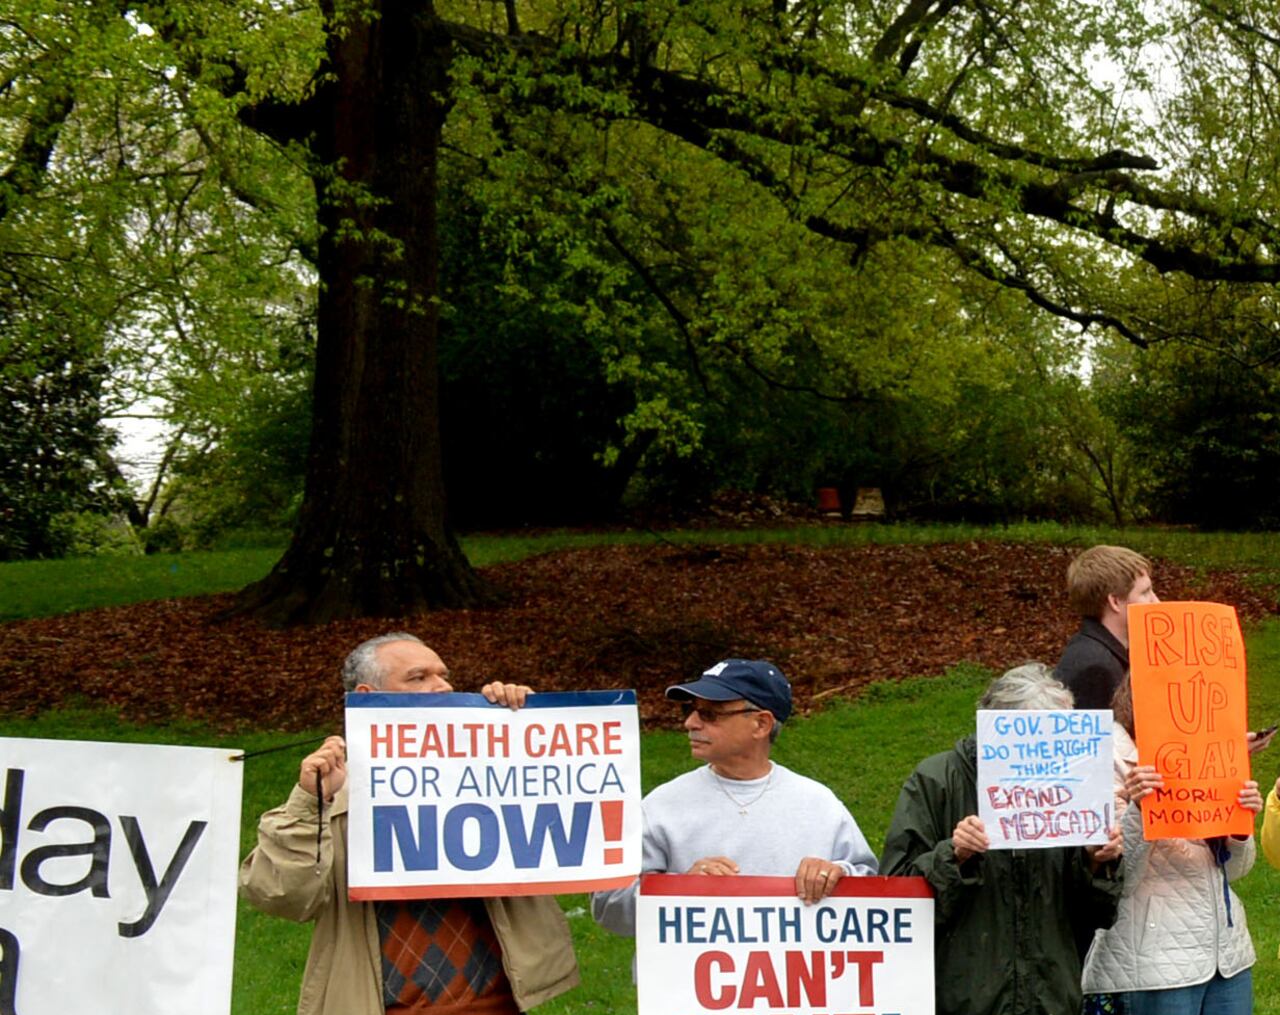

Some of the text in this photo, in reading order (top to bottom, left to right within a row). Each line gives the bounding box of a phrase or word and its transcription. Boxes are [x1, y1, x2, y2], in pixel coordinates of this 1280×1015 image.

[1144, 611, 1237, 669] RISE
[1167, 671, 1228, 735] UP
[369, 721, 623, 759] HEALTH CARE
[994, 713, 1111, 736] GOV. DEAL
[982, 737, 1101, 760] DO THE RIGHT
[370, 762, 626, 798] FOR AMERICA
[987, 784, 1073, 810] EXPAND
[1155, 788, 1224, 803] MORAL
[1000, 803, 1111, 842] MEDICAID!
[1149, 805, 1235, 825] MONDAY
[372, 799, 625, 873] NOW!
[658, 906, 913, 944] HEALTH CARE
[693, 950, 885, 1010] CAN'T
